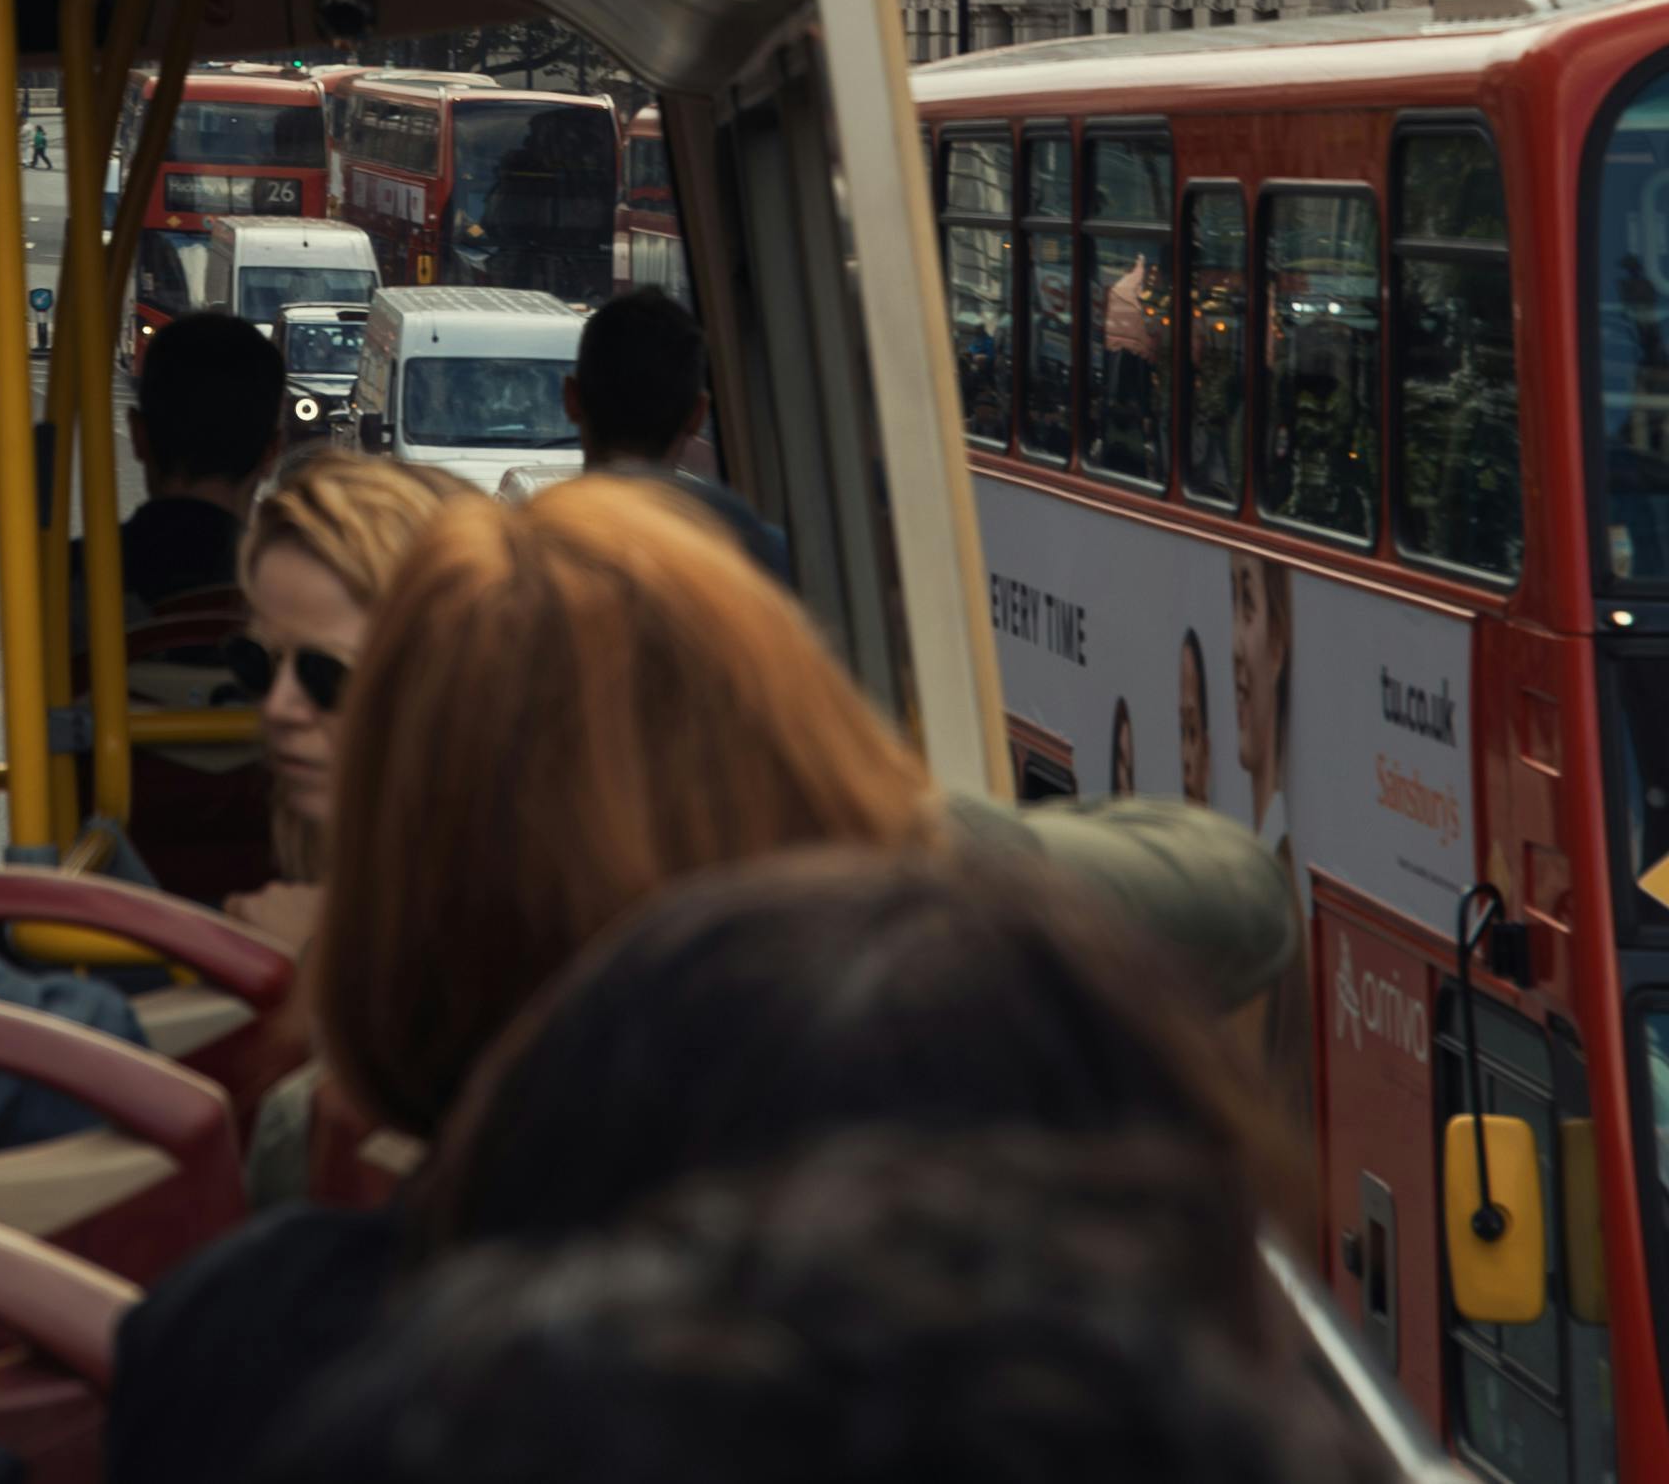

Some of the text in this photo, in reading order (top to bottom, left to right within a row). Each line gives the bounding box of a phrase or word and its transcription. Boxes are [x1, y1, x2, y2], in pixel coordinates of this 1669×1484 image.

[267, 181, 297, 203] 26
[989, 572, 1088, 668] EVERY TIME
[1379, 665, 1458, 750] tu.co.uk
